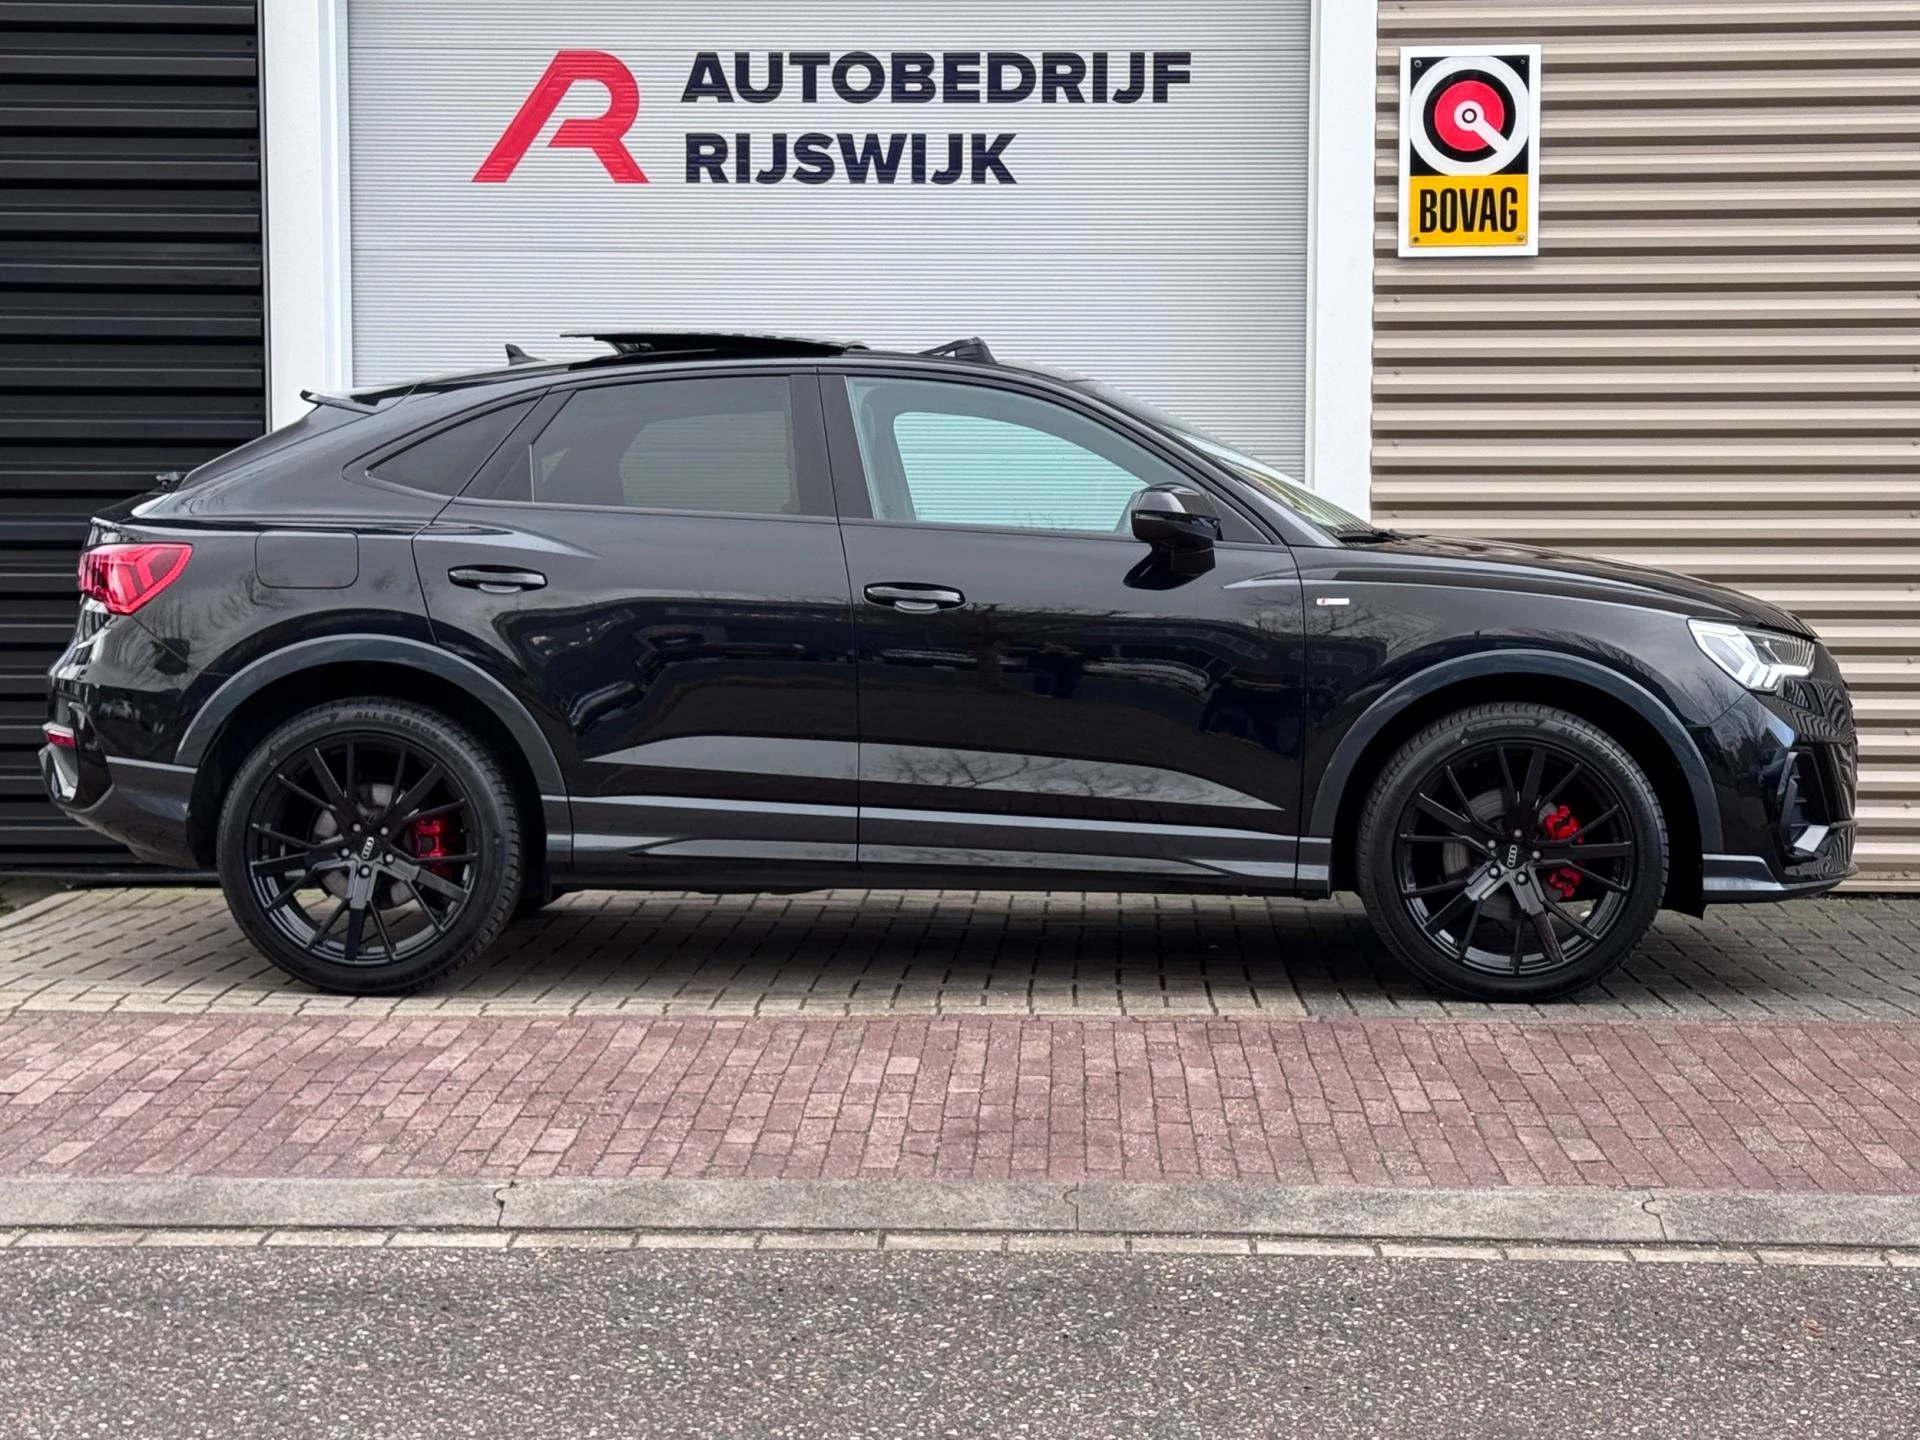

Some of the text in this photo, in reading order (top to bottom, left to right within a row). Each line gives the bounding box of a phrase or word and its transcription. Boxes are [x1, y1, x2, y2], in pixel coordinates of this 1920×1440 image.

[680, 52, 1192, 103] AUTOBEDRIJF
[686, 133, 1017, 184] RIJSWIJK
[1420, 187, 1518, 233] BOVAG
[353, 711, 440, 740] ALL SEASON
